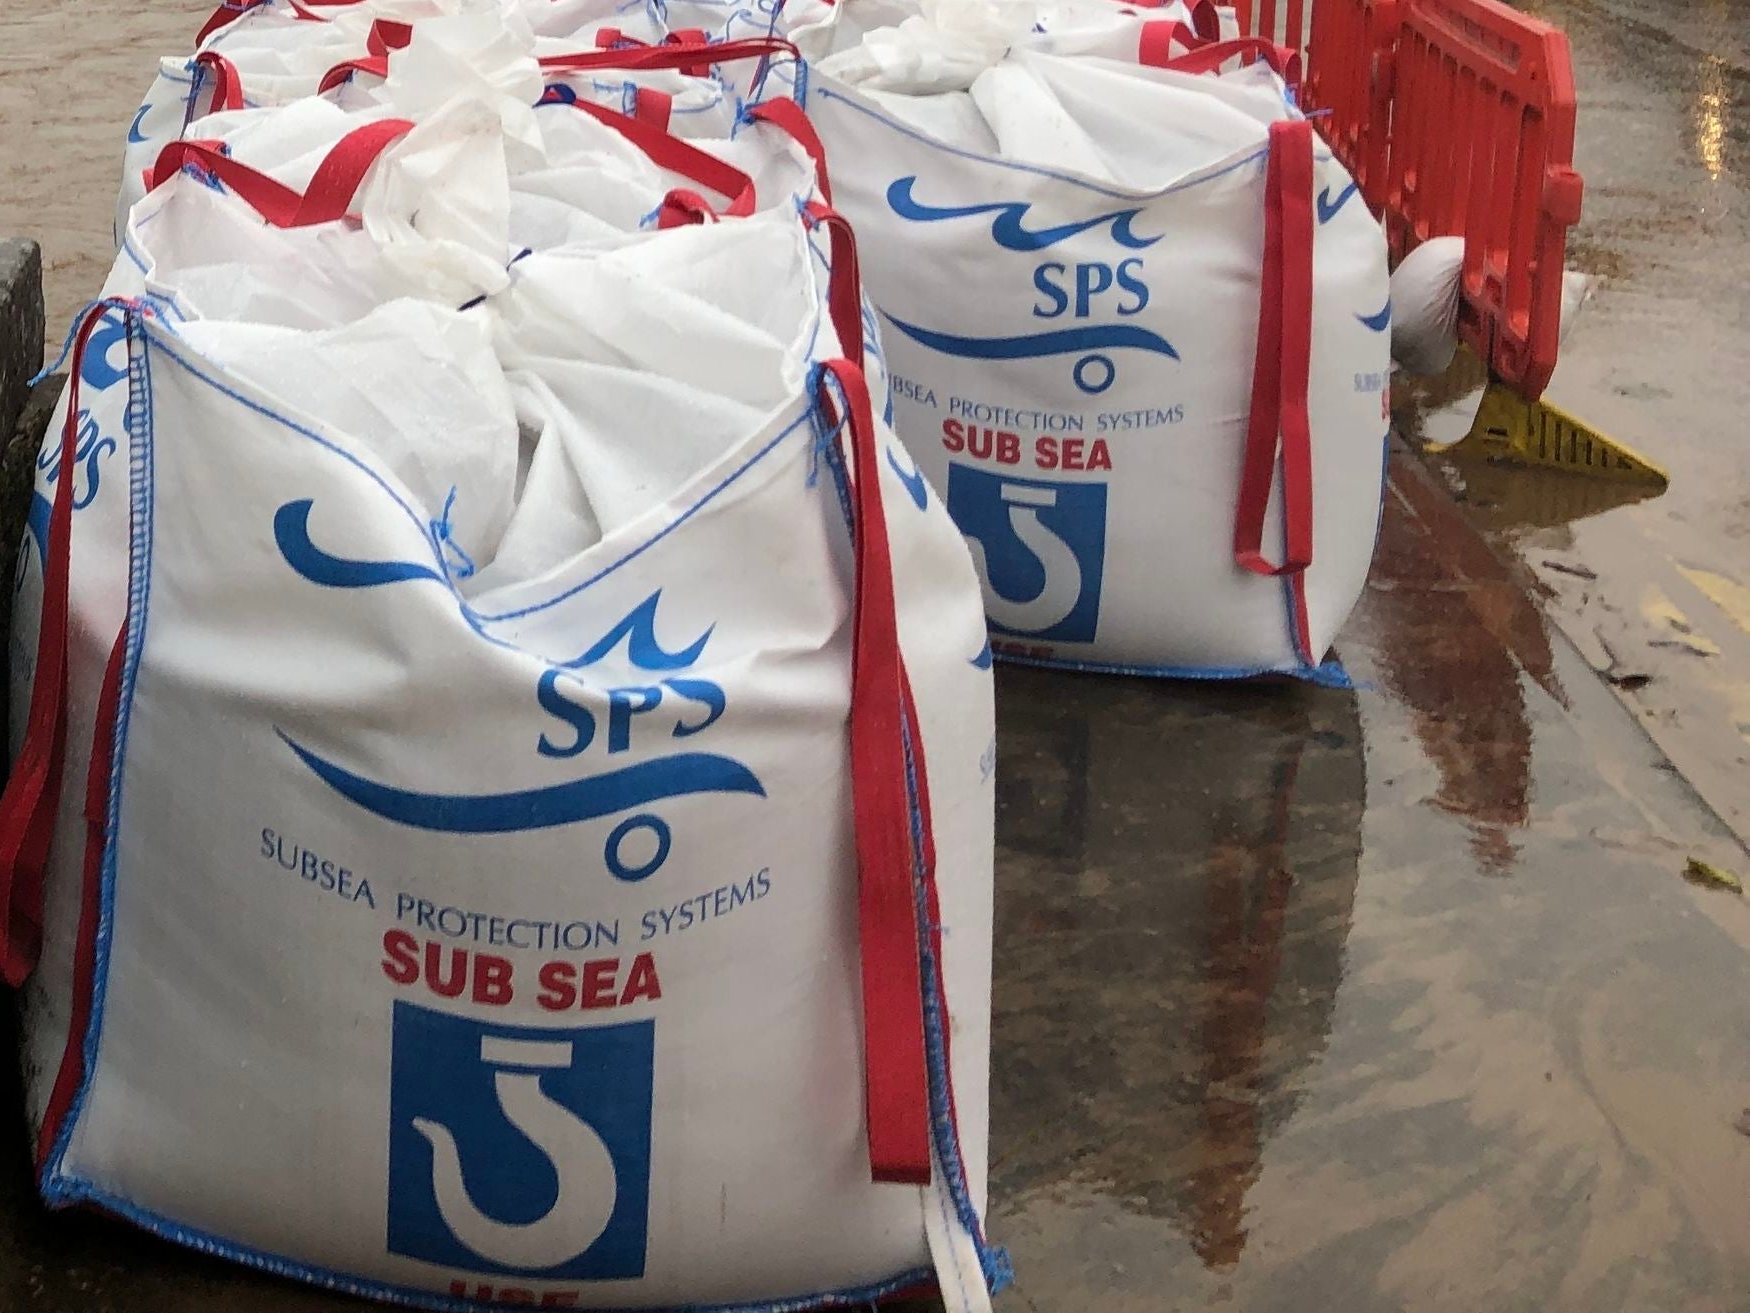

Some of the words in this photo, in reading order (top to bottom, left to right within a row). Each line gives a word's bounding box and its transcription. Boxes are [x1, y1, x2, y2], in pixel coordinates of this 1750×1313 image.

[1033, 257, 1149, 318] SPS
[942, 418, 1021, 466] SUB
[1035, 436, 1112, 472] SEA
[949, 396, 1084, 432] PROTECTION
[1097, 403, 1185, 433] SYSTEMS
[537, 668, 726, 758] SPS
[260, 827, 376, 910] SUBSEA
[396, 892, 620, 950] PROTECTION
[641, 867, 771, 940] SYSTEMS
[381, 928, 514, 1006] SUB
[536, 951, 662, 1011] SEA
